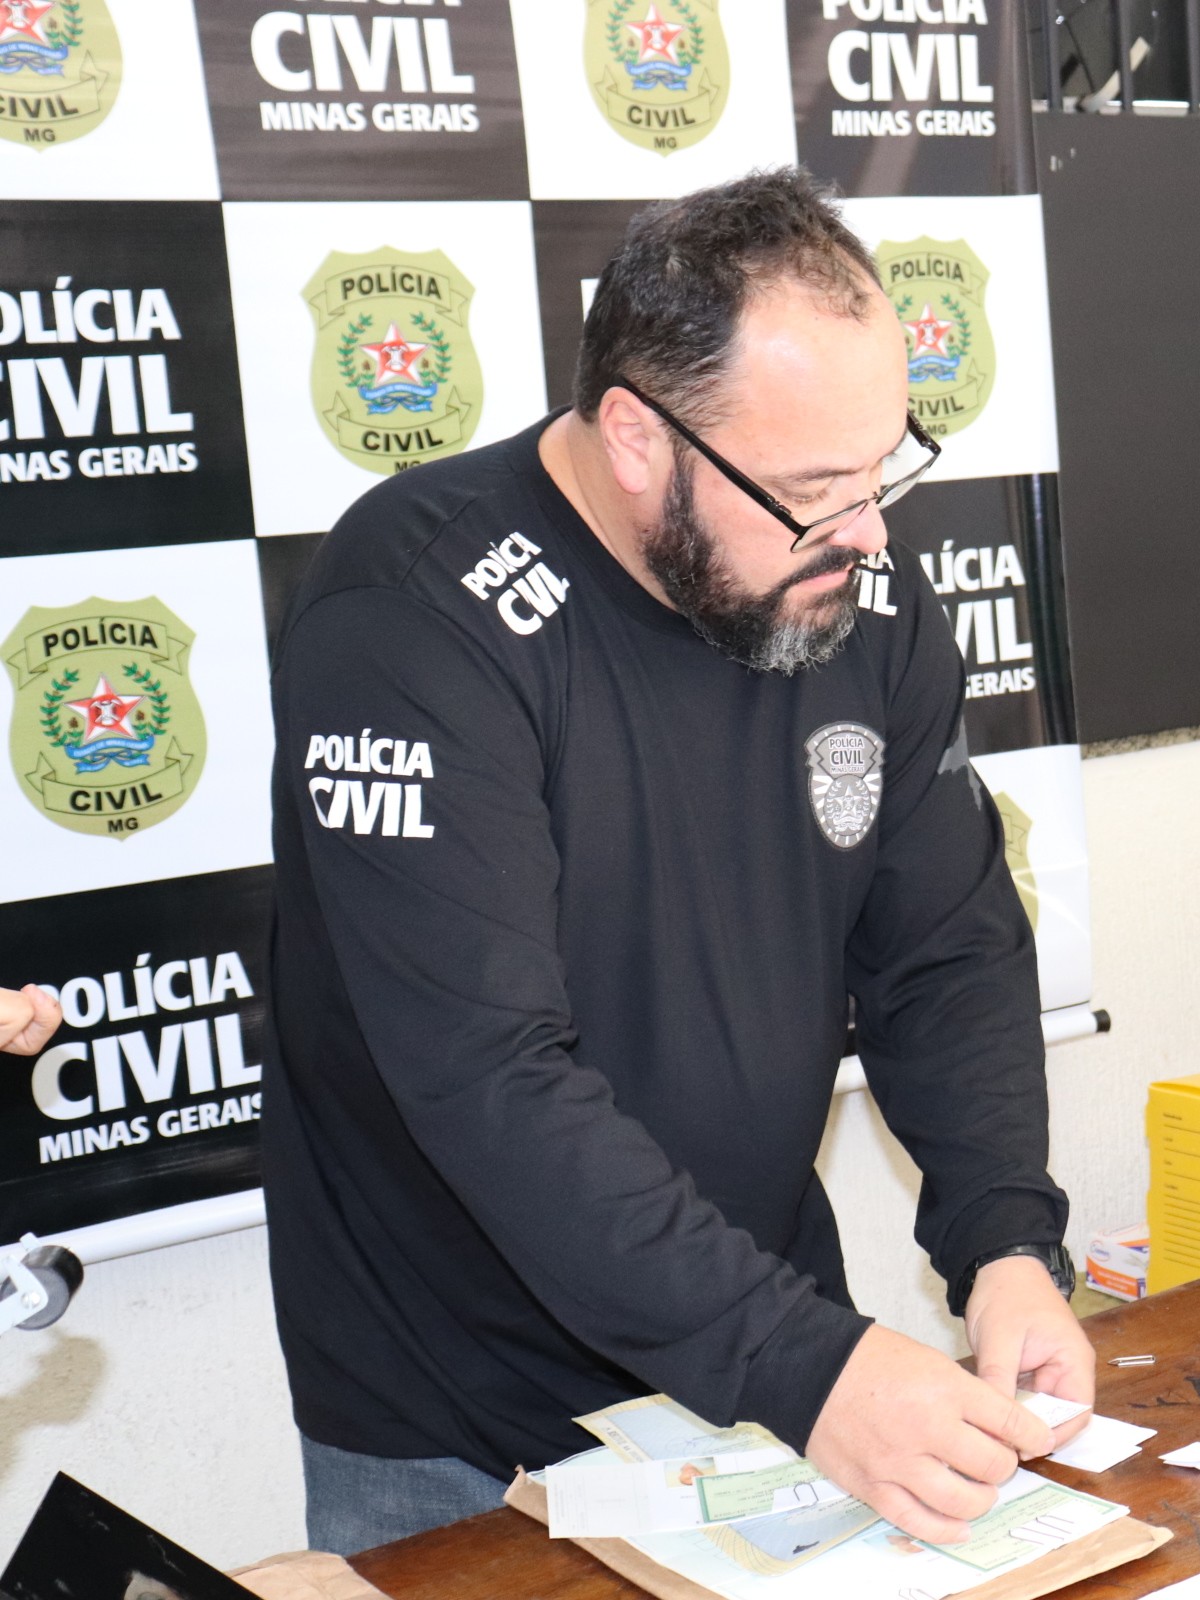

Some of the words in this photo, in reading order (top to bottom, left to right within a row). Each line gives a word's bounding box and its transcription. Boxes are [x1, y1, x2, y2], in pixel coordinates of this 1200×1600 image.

[251, 11, 475, 94] CIVIL
[827, 29, 994, 102] CIVIL
[0, 94, 79, 118] IVIL
[259, 101, 367, 132] MINAS
[371, 102, 480, 132] GERAIS
[627, 104, 696, 128] CIVIL
[831, 110, 912, 136] MINAS
[916, 110, 996, 137] GERAIS
[23, 127, 56, 142] MG
[654, 136, 677, 149] MG
[341, 264, 442, 300] POLÍCIA
[0, 276, 182, 346] LÍCIA
[0, 354, 194, 442] IVIL
[362, 428, 443, 452] CIVIL
[0, 450, 71, 483] NAS
[78, 442, 198, 479] GERAIS
[920, 539, 1026, 595] LÍCIA
[43, 616, 158, 657] POLÍCIA
[304, 728, 434, 778] POLÍCIA
[829, 735, 864, 748] POLÍCIA
[831, 750, 864, 765] CIVIL
[69, 783, 163, 812] CIVIL
[309, 776, 435, 838] CIVIL
[107, 817, 139, 833] MG
[36, 951, 254, 1029] OLÍCIA
[31, 1013, 262, 1121] CIVIL
[39, 1116, 150, 1164] MINAS
